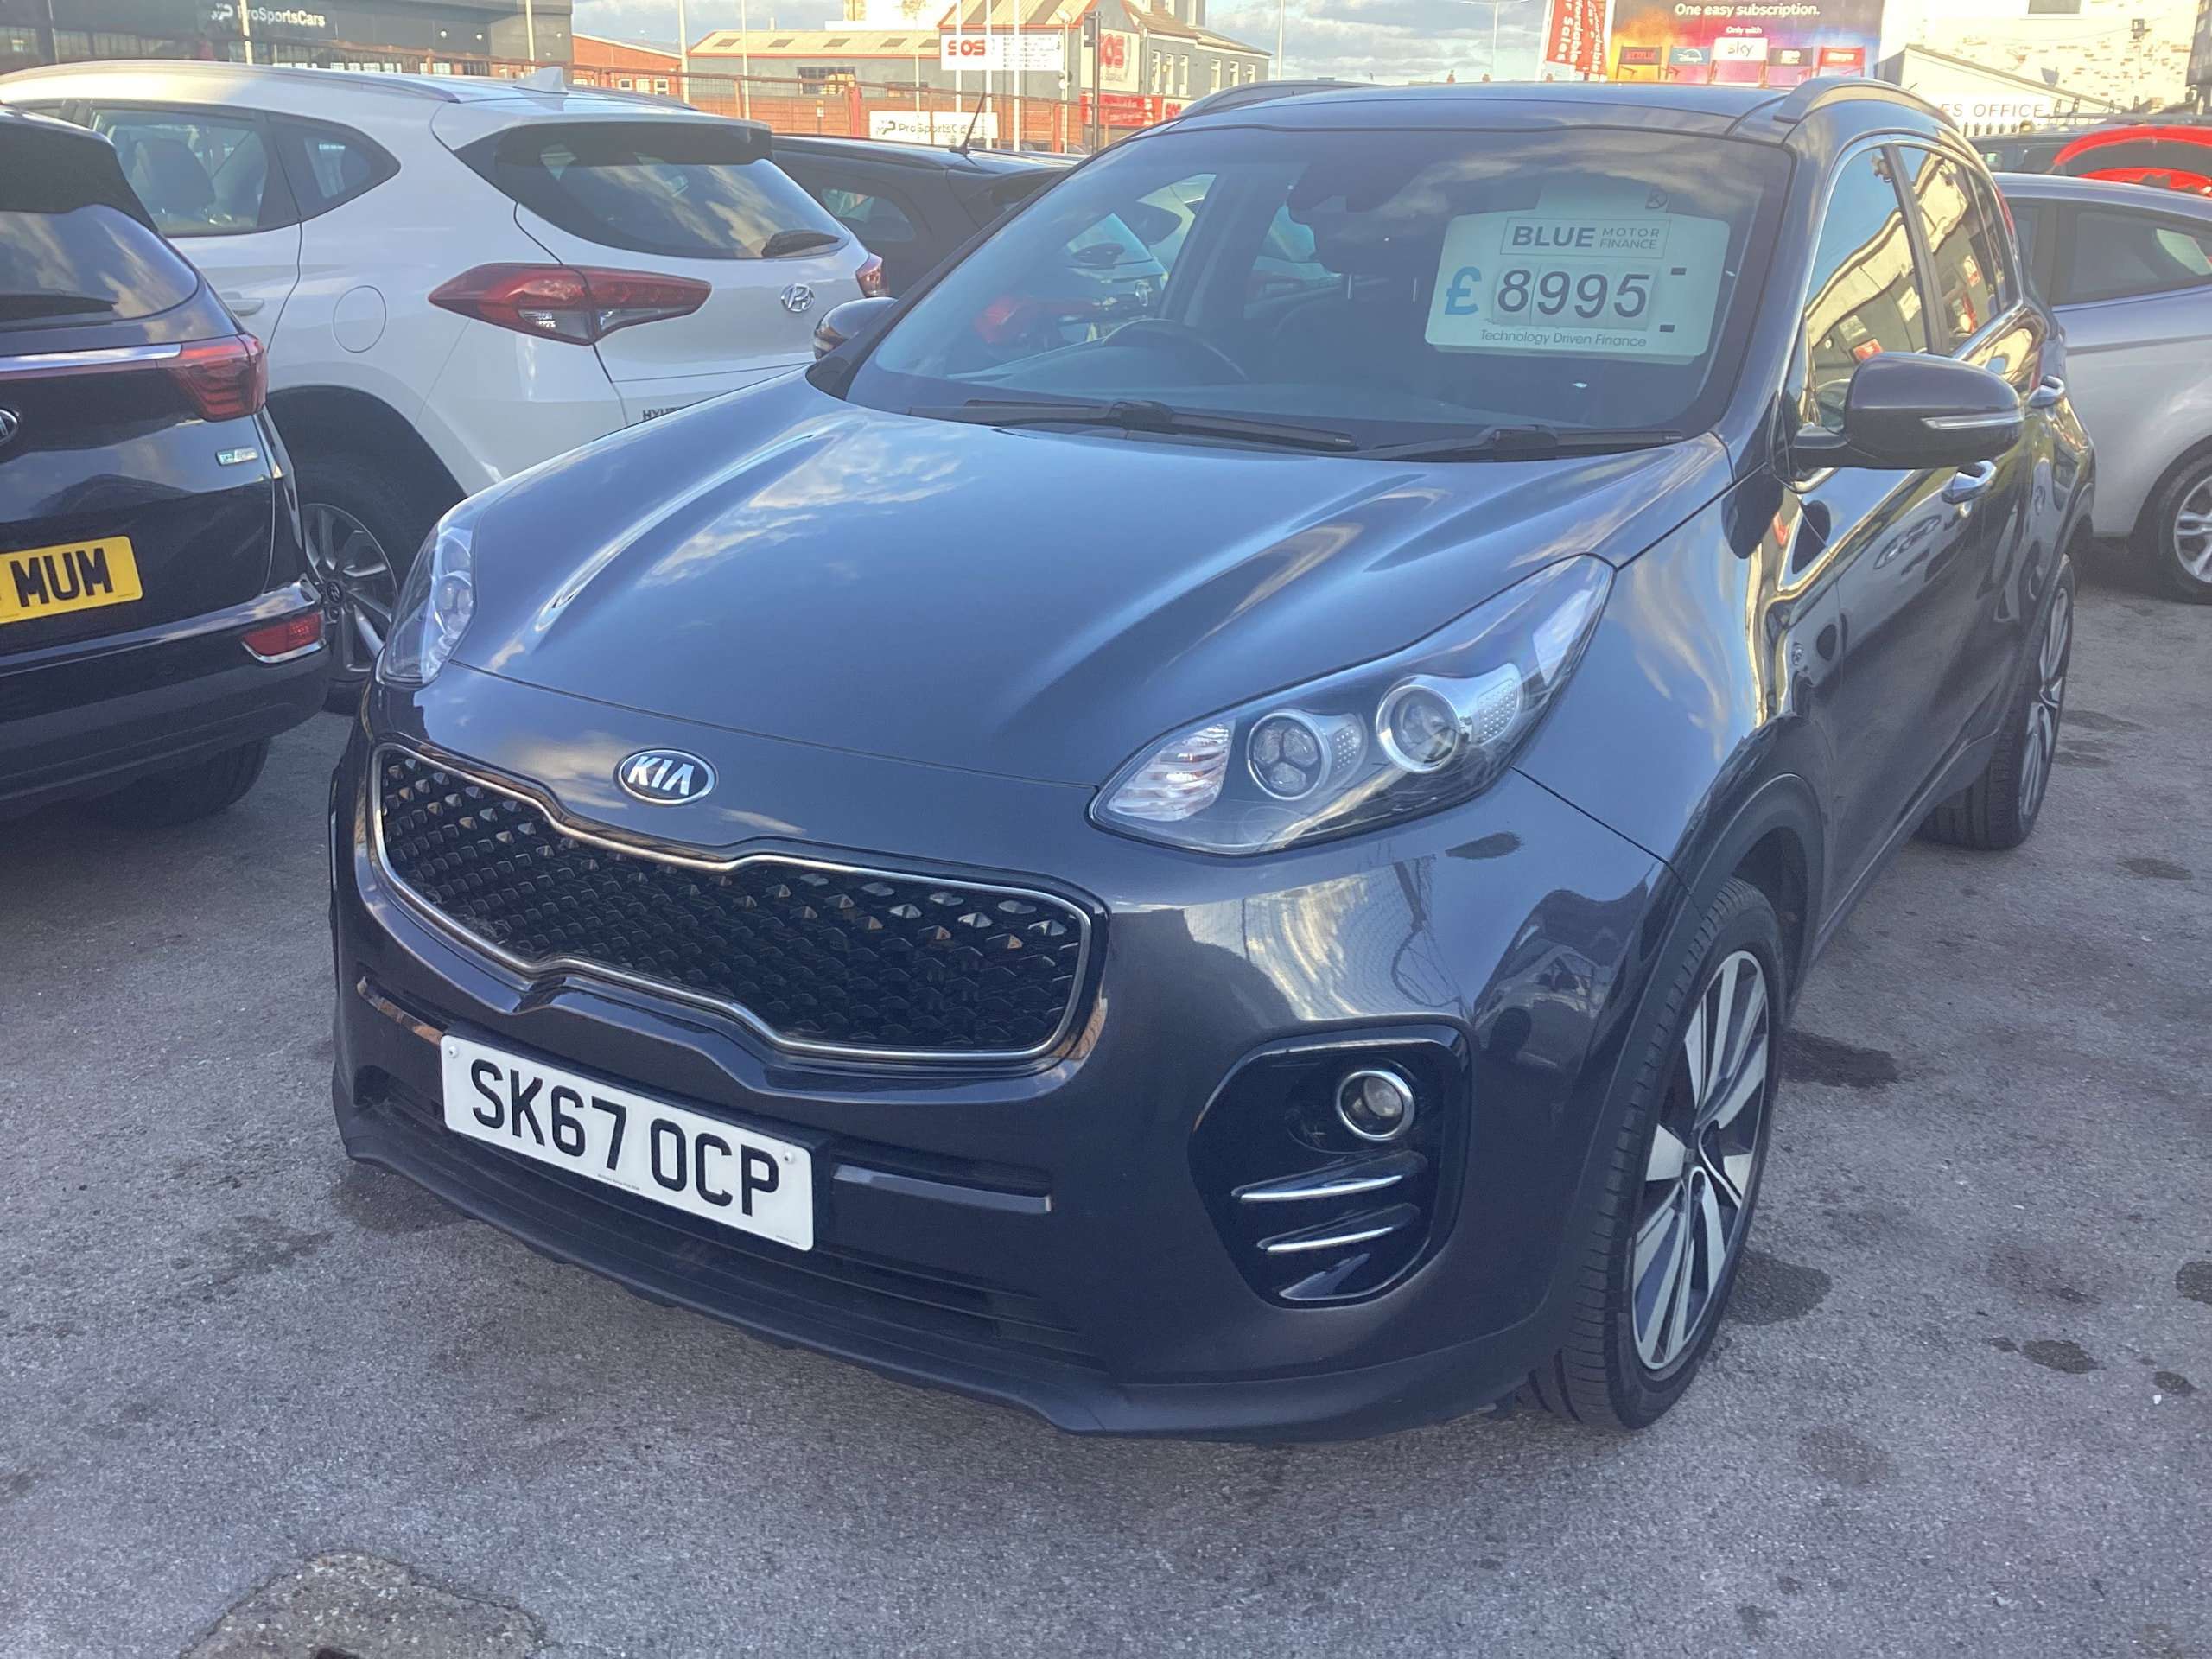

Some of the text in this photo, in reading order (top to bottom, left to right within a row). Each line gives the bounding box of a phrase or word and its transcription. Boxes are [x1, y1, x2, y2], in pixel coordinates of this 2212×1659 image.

[1675, 3, 1821, 18] One easy subscription.
[1728, 41, 1754, 56] sky
[1974, 104, 2044, 118] OFFICE
[1512, 226, 1660, 248] BLUE MOTOR
[1599, 238, 1657, 250] FINANCE
[1481, 329, 1647, 347] Technology Driven Finance
[10, 547, 114, 608] MUM
[627, 755, 695, 796] KIA
[470, 1058, 780, 1217] SK67 OCP
